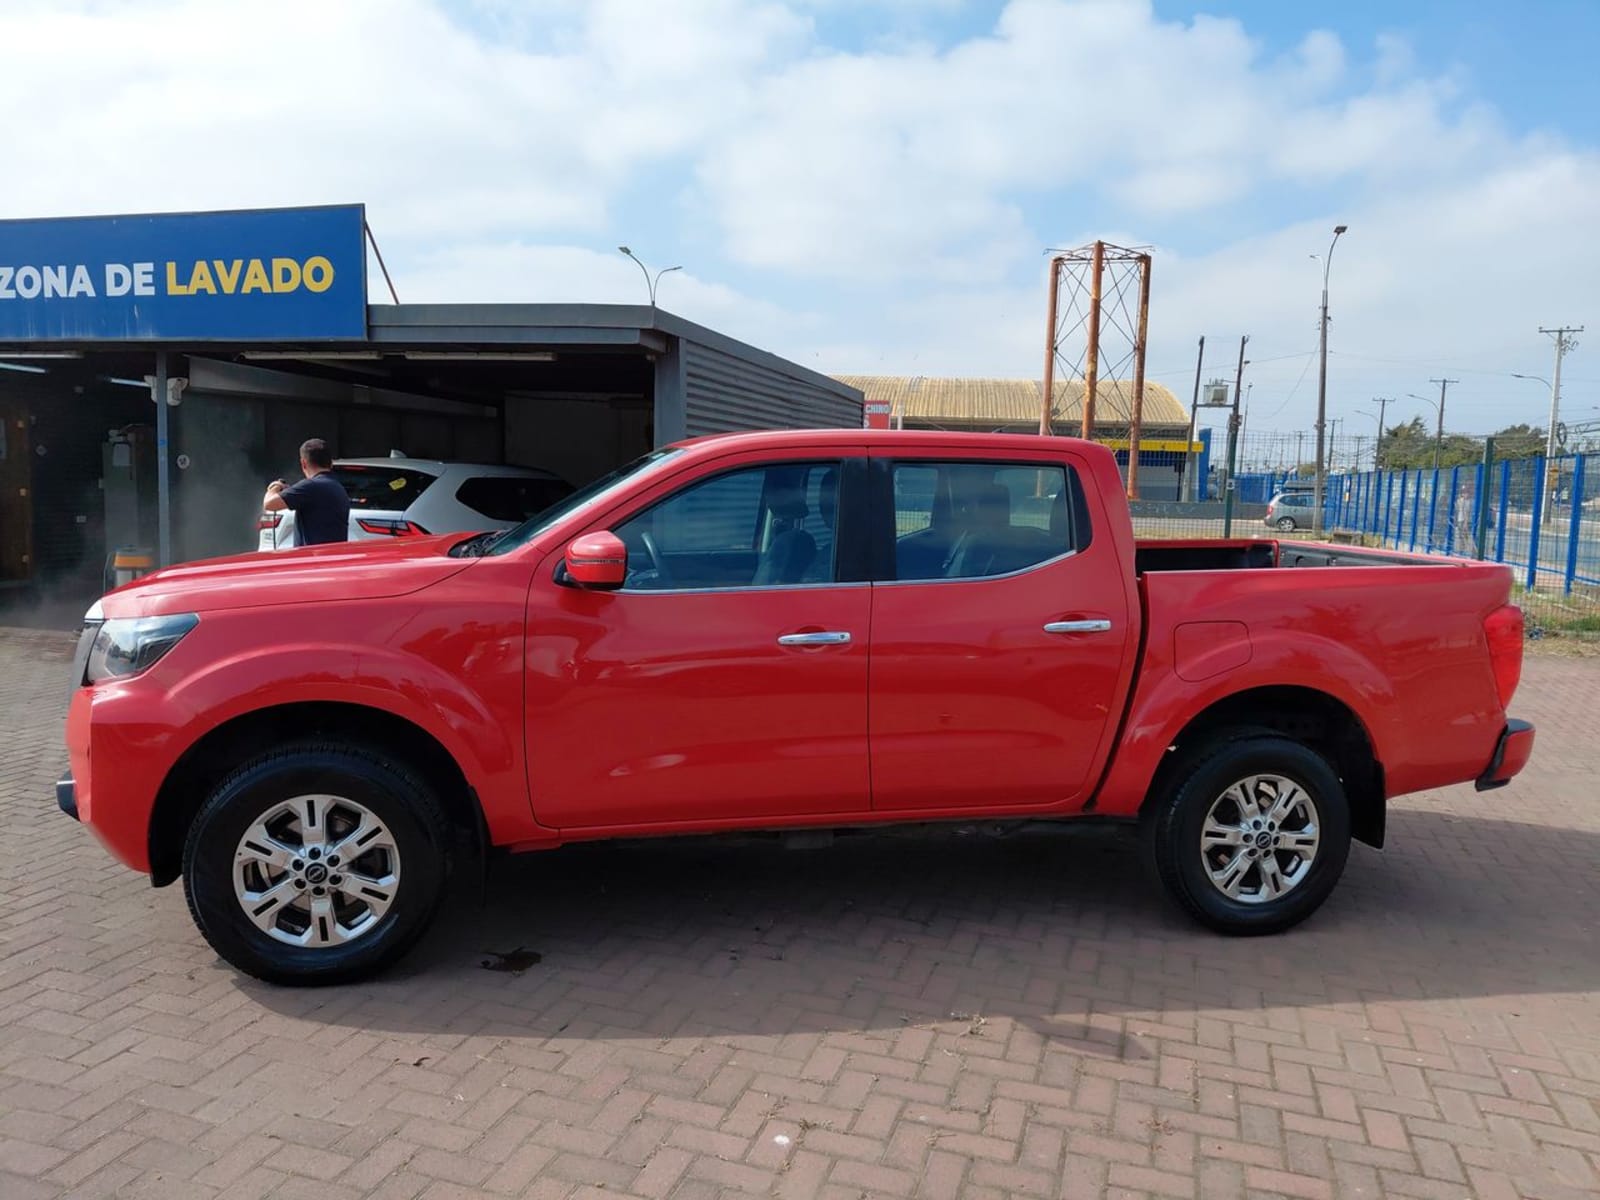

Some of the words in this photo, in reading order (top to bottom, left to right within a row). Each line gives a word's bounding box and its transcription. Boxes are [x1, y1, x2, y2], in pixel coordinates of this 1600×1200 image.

[0, 264, 96, 299] ZONA
[105, 262, 155, 297] DE
[166, 256, 334, 295] LAVADO
